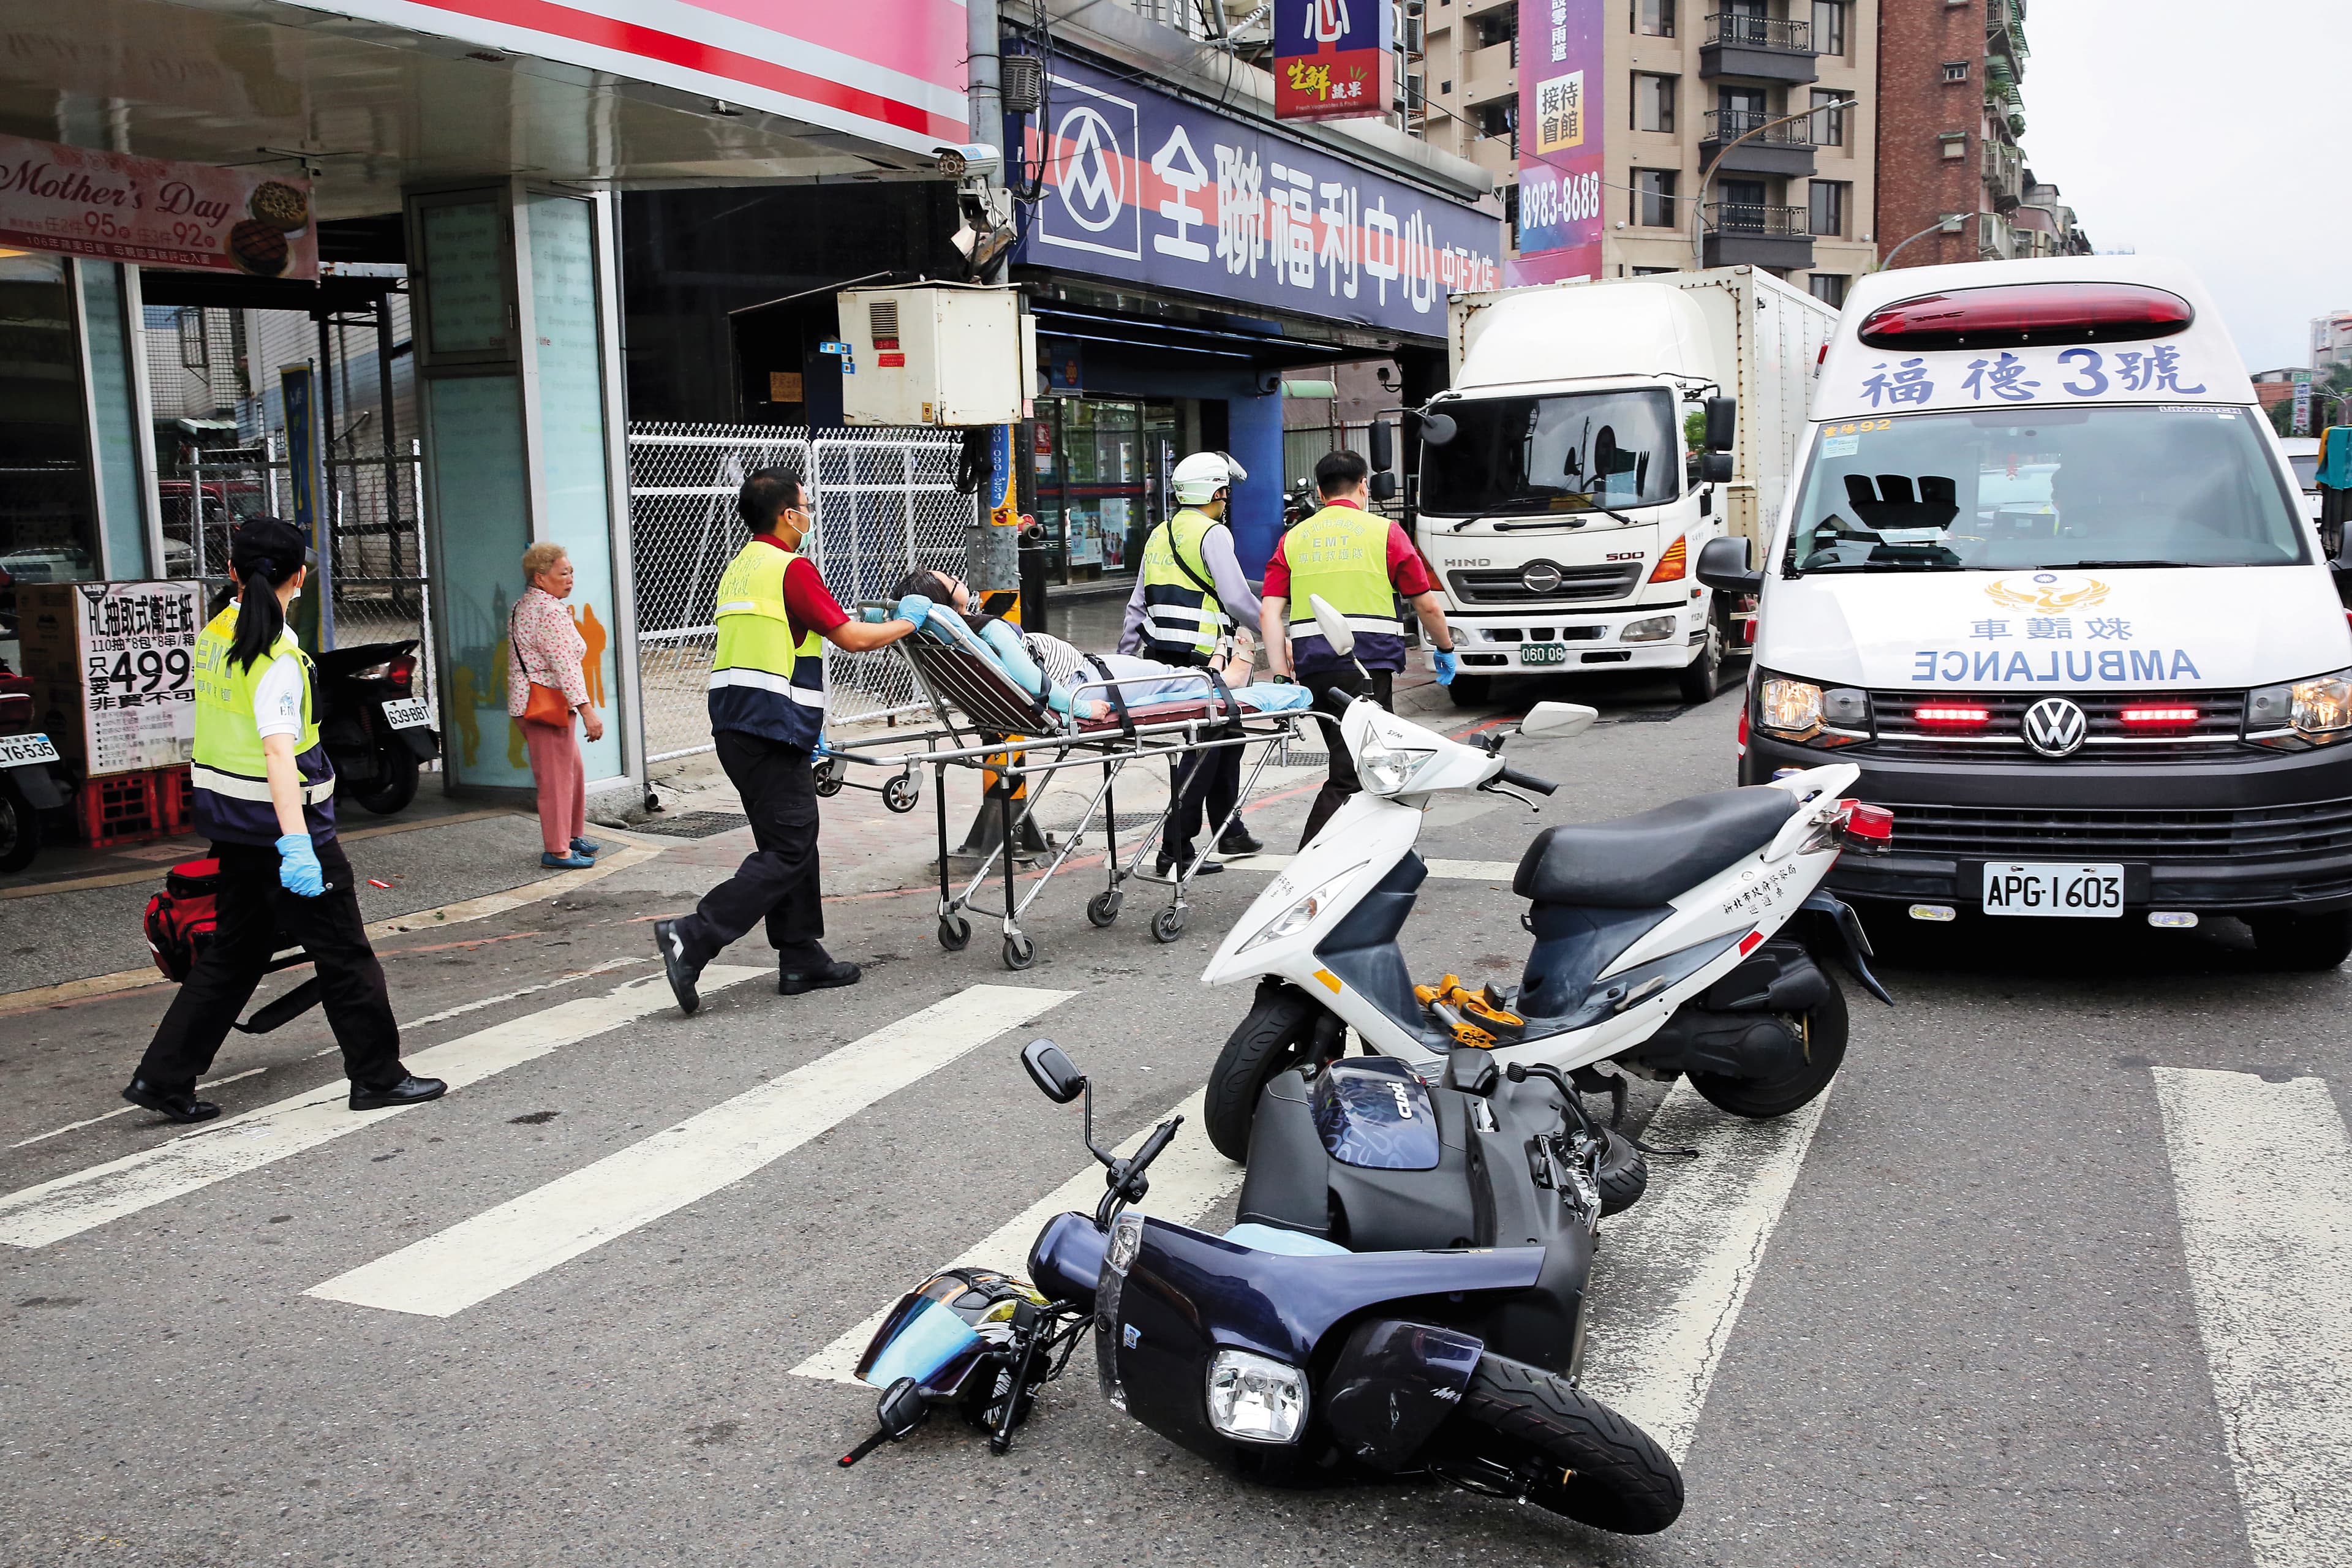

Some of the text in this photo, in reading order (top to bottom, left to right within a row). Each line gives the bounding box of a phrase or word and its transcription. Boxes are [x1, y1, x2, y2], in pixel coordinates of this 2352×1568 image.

[1303, 0, 1350, 42] 心
[1287, 57, 1362, 102] 生鮮 蔬果
[1542, 81, 1577, 115] 接待
[1542, 111, 1577, 145] 會館
[0, 160, 143, 209] Mother's
[156, 181, 232, 227] Day
[1523, 171, 1599, 230] 8983-8688
[1150, 124, 1436, 314] 全聯福利中心
[1860, 345, 2206, 408] 福德3號
[1313, 535, 1349, 548] EMT
[1606, 551, 1645, 561] 500
[1444, 558, 1491, 567] HINO
[89, 657, 110, 696] 只要
[109, 649, 190, 693] 499
[90, 689, 195, 710] 非買不可
[388, 706, 430, 725] 639-BBT
[1387, 729, 1403, 739] SYM
[1988, 876, 2119, 908] APG-1603
